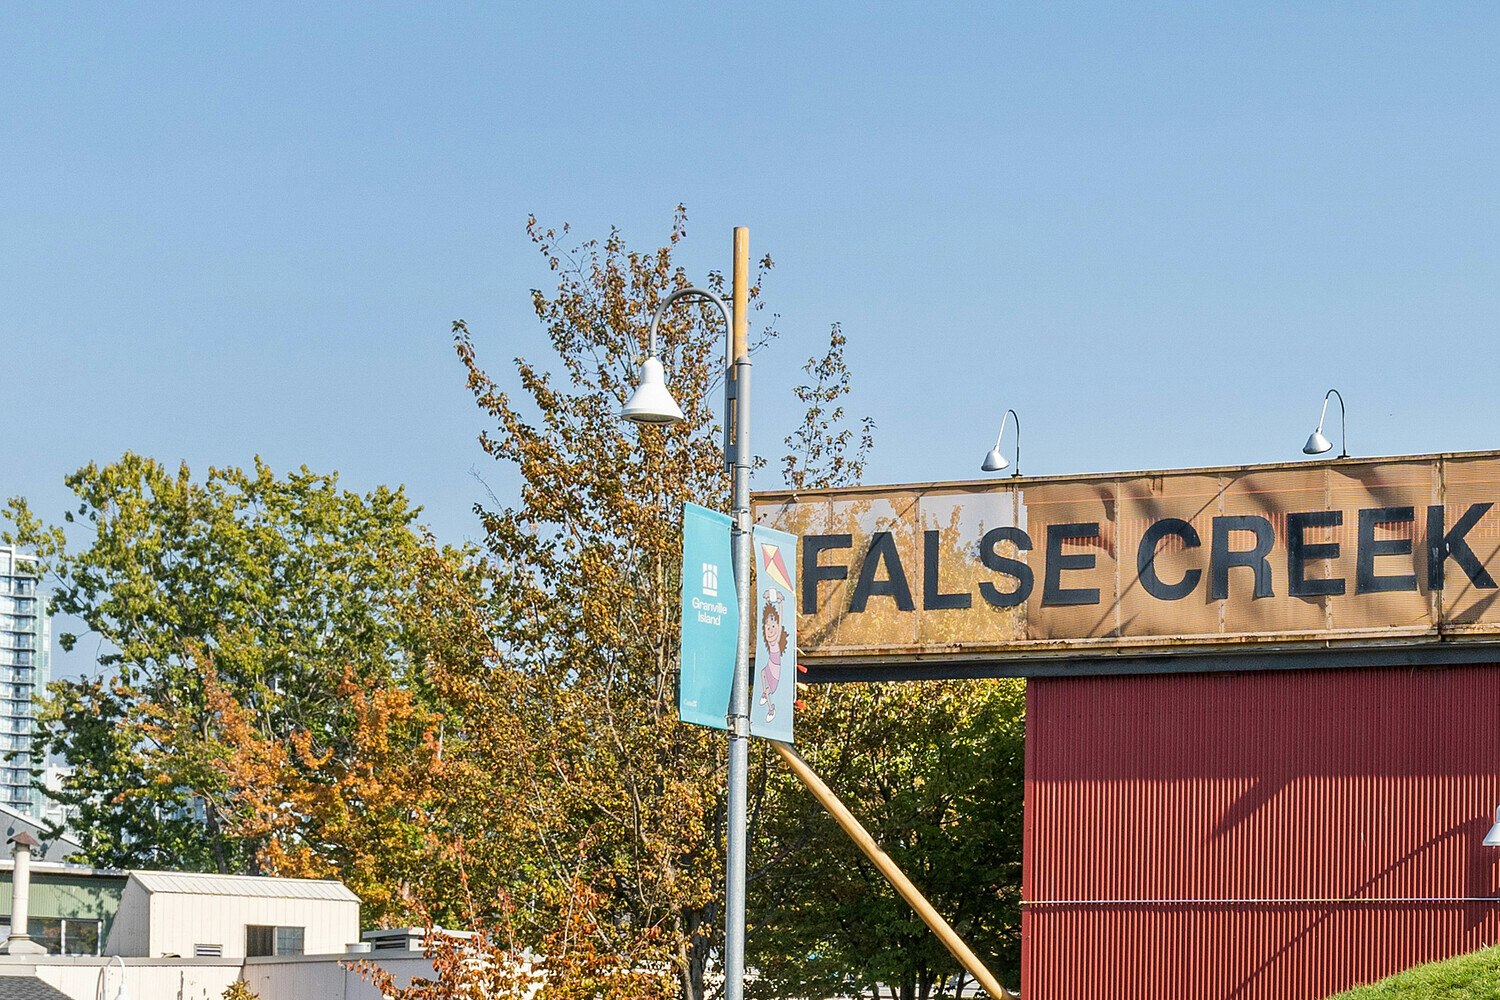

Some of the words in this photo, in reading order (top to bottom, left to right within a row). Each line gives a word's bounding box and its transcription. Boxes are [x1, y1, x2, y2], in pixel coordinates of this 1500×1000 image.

[802, 522, 1100, 615] FALSE
[1137, 502, 1499, 601] CREEK
[691, 596, 728, 615] Granville
[697, 610, 721, 626] Island
